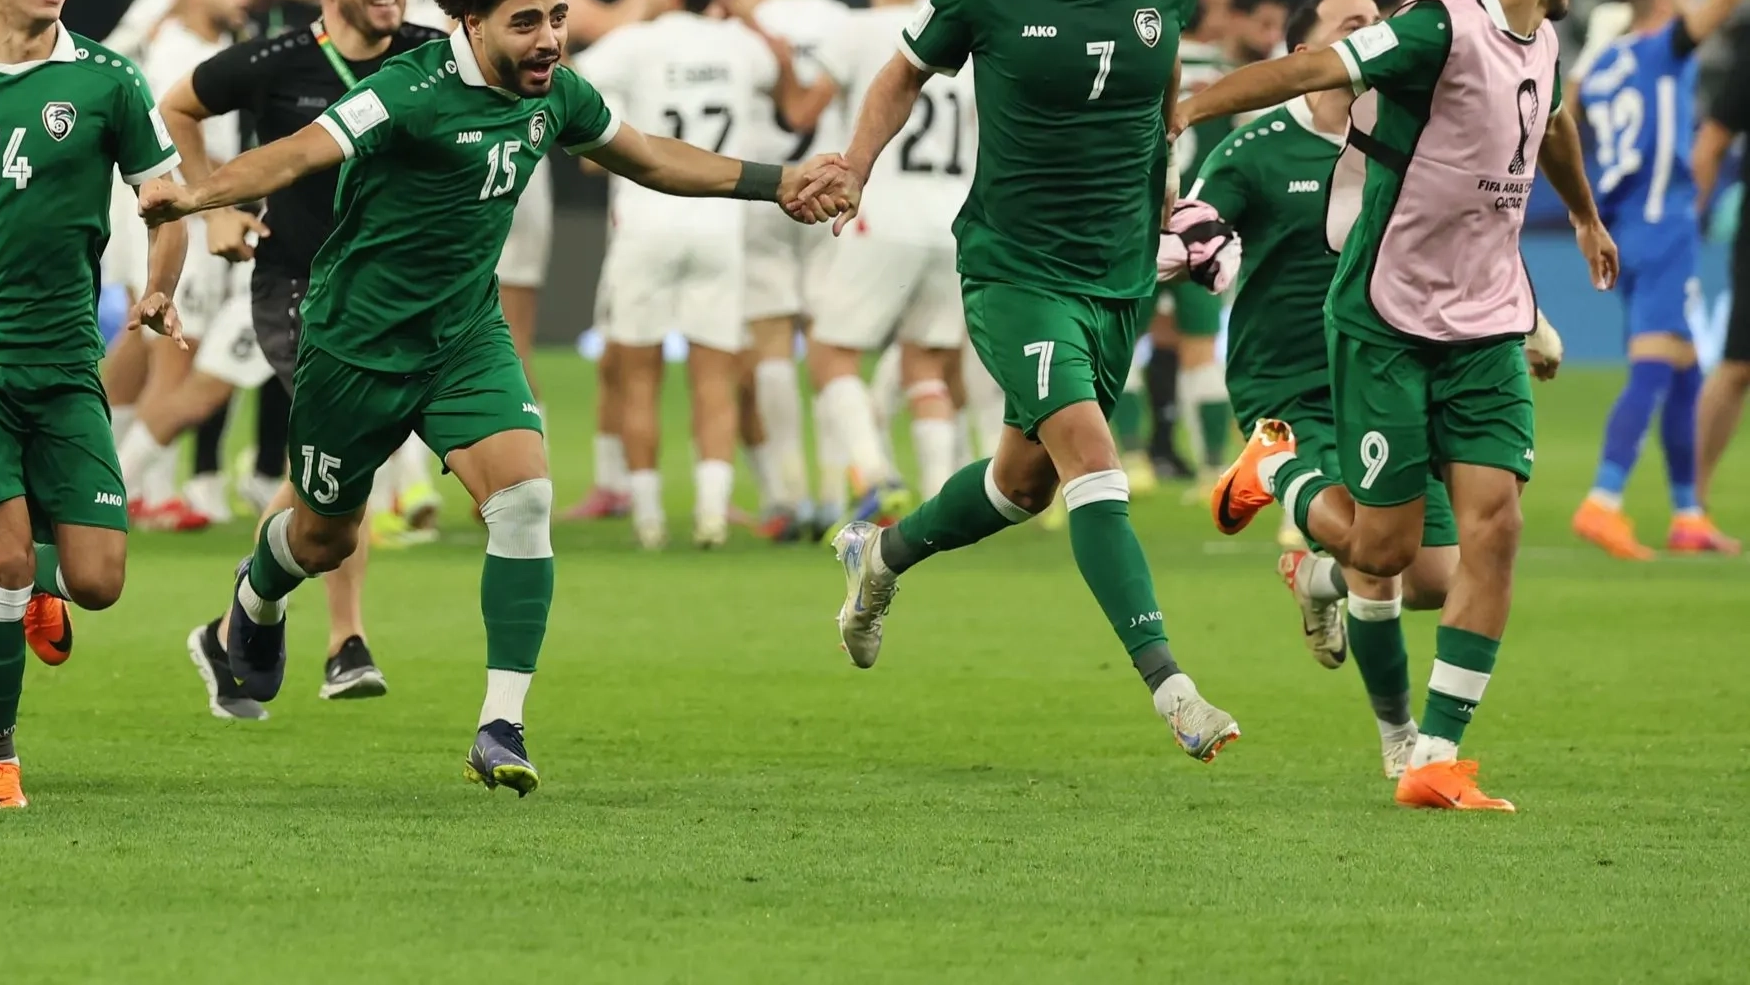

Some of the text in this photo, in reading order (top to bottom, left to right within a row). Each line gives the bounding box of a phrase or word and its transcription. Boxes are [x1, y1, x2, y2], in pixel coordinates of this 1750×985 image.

[1021, 25, 1058, 38] JAKO
[1086, 40, 1116, 101] 7
[456, 131, 483, 145] JAKO
[897, 88, 967, 175] 21
[479, 139, 522, 201] 15
[1288, 180, 1320, 193] JAKO
[1477, 179, 1501, 193] FIFA
[1501, 182, 1524, 194] ARAB
[1494, 196, 1523, 211] QATAR
[1023, 340, 1055, 401] 7
[522, 402, 541, 417] JAK
[1360, 430, 1389, 490] 9
[301, 444, 342, 504] 15
[93, 491, 123, 507] JAKO
[1129, 610, 1163, 628] JAKO
